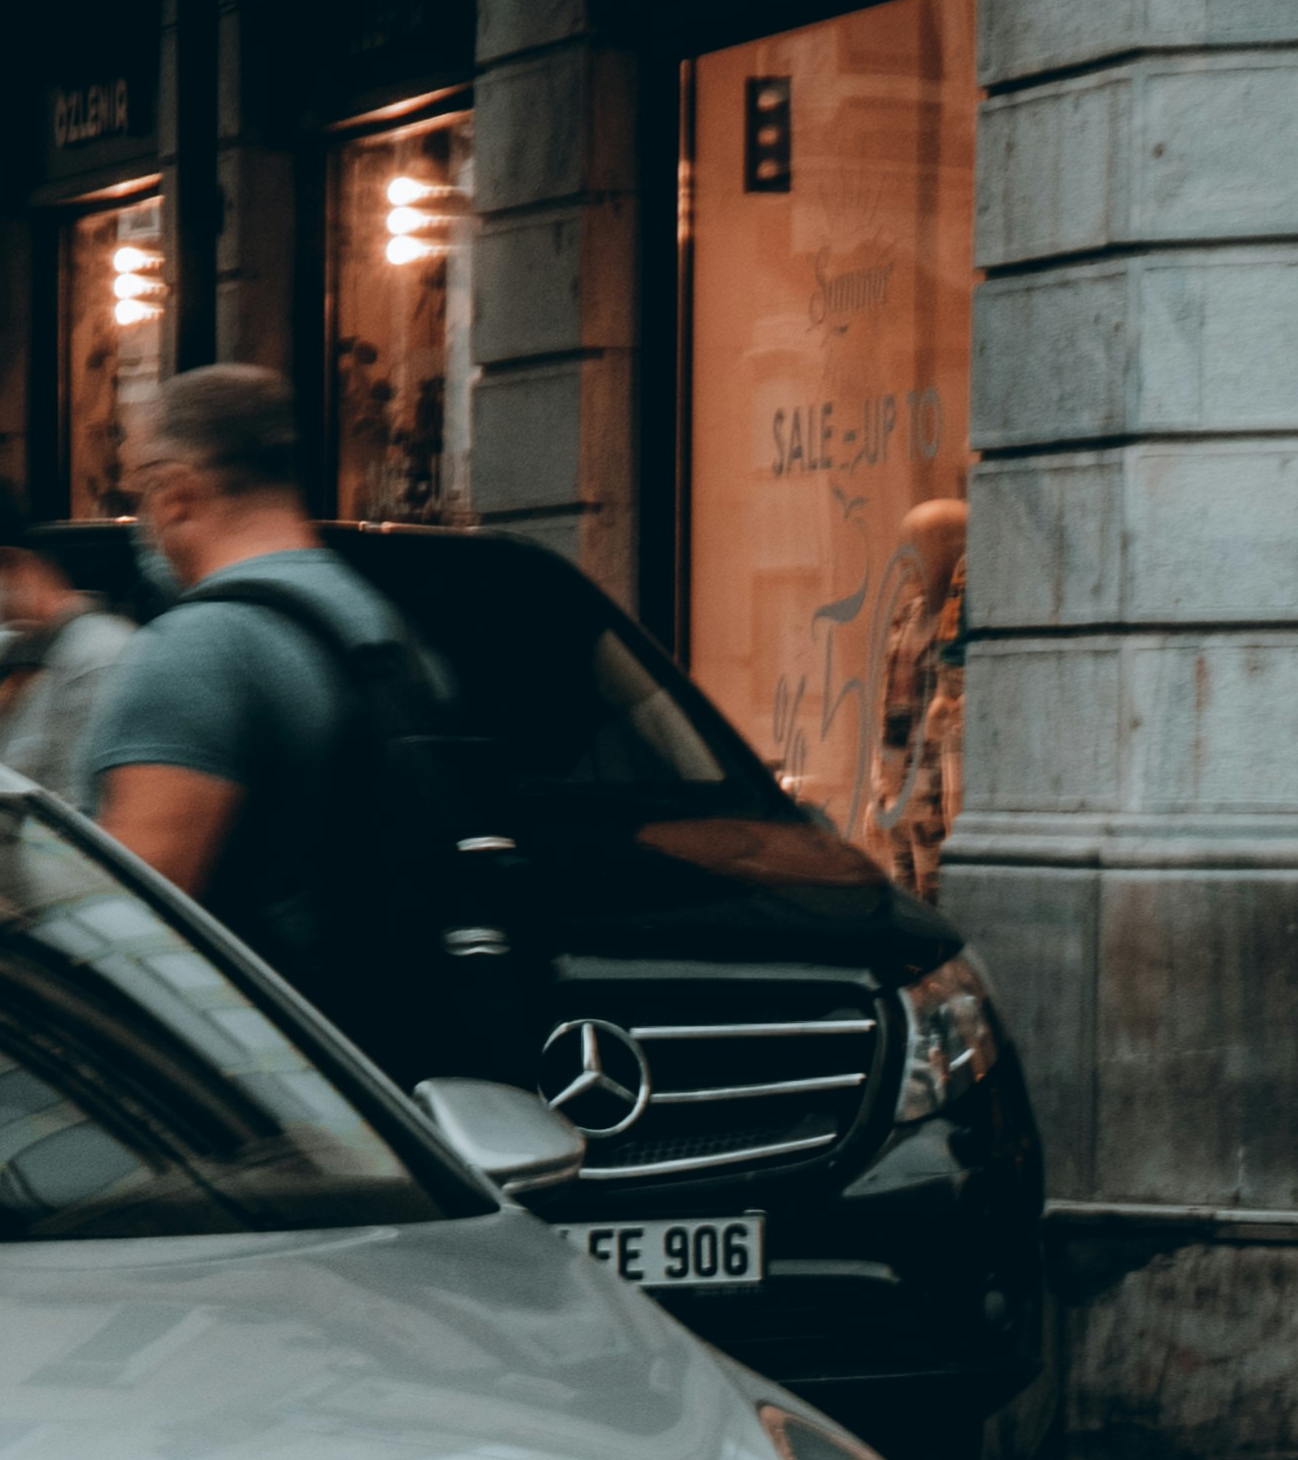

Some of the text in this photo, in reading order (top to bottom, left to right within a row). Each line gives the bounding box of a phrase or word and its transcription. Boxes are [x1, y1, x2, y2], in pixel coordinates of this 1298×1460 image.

[771, 401, 833, 477] SALE
[861, 394, 897, 467] UP
[907, 386, 944, 462] TO
[664, 1222, 749, 1278] 906
